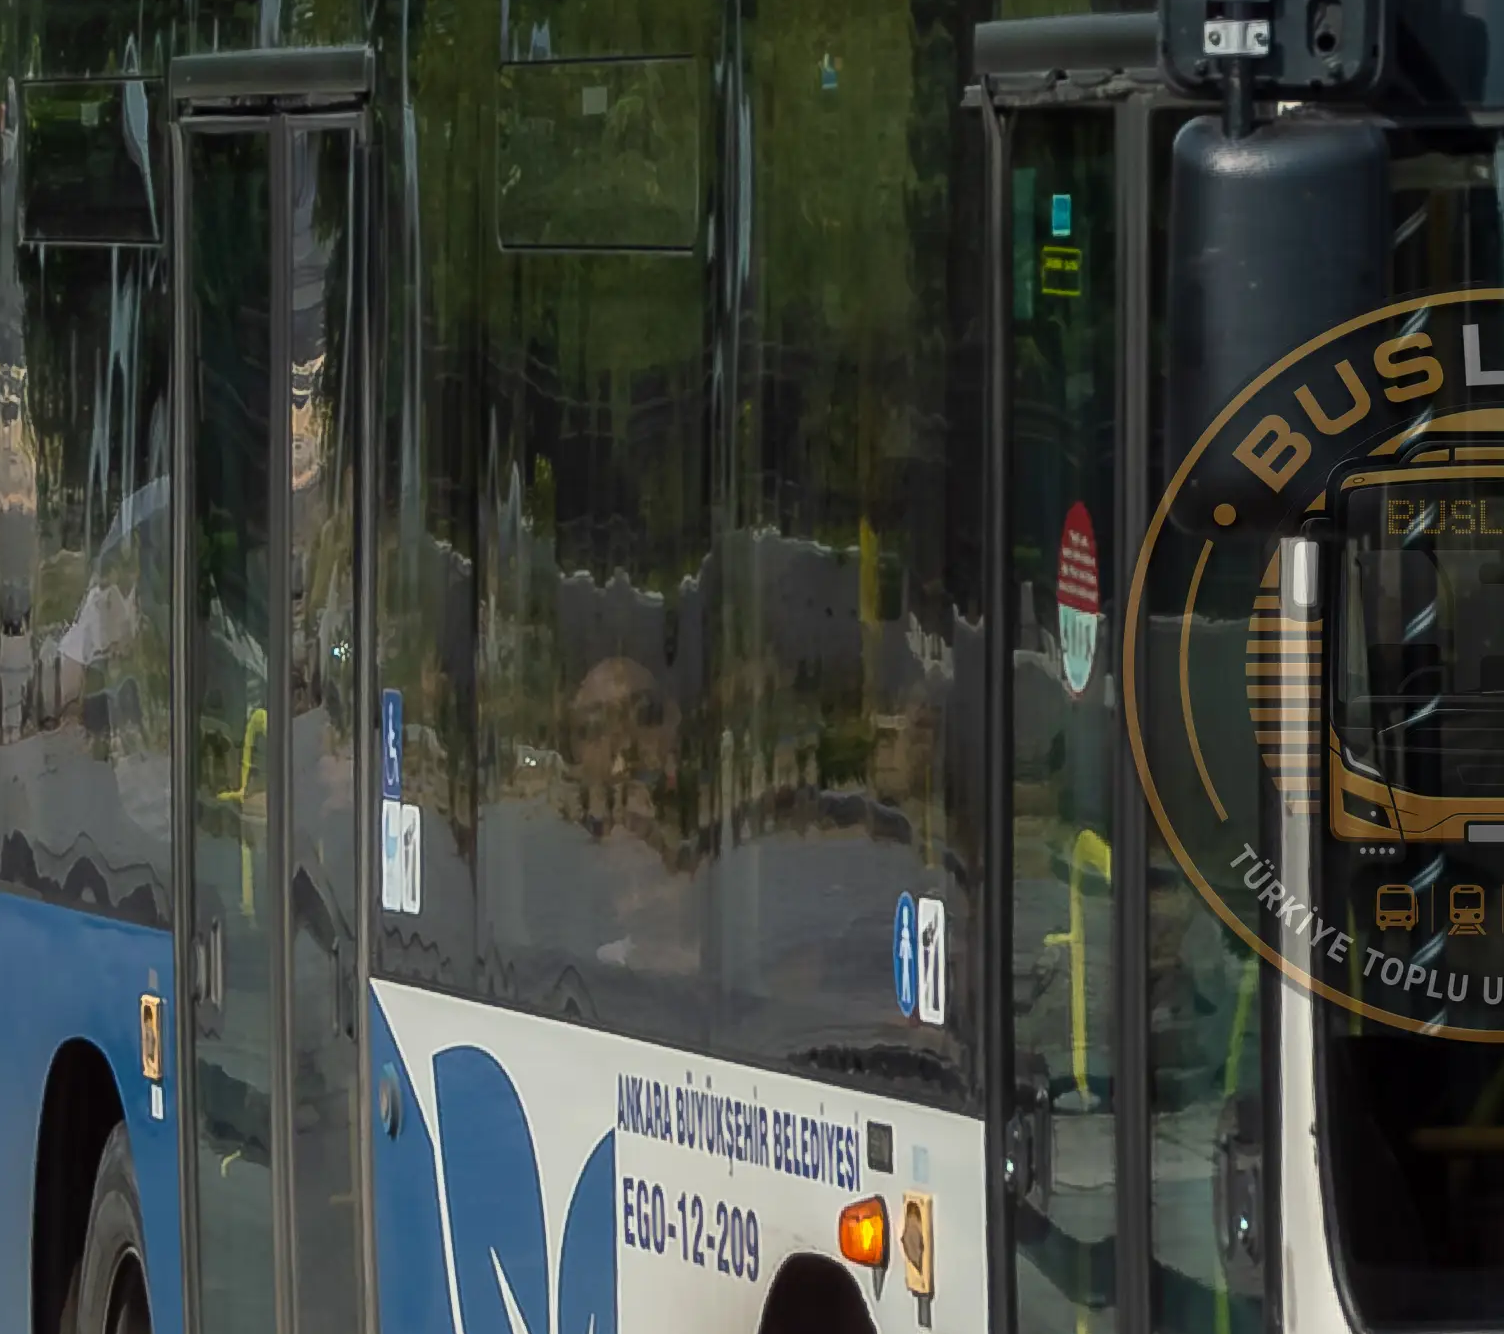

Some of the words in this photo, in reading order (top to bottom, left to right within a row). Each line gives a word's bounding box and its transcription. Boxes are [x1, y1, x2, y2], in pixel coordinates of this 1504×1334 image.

[617, 1072, 673, 1144] ANKARA
[676, 1070, 770, 1177] BÜYÜKŞEHİR
[773, 1102, 861, 1193] BELEDİYESİ
[623, 1178, 759, 1282] EGO-12-209
